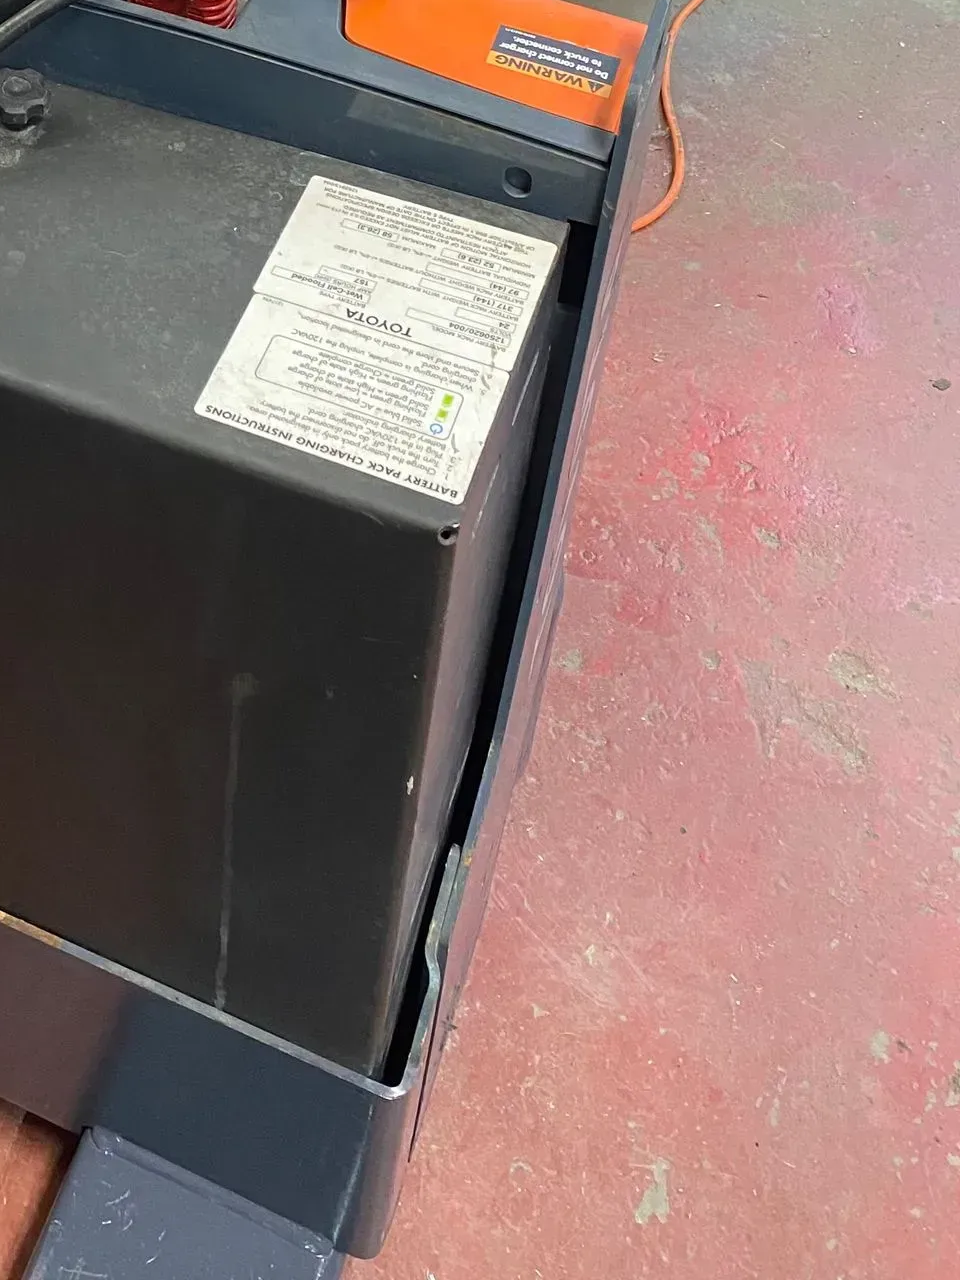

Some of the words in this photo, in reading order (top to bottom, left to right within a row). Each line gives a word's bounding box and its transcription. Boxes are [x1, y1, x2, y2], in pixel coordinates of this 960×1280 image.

[499, 42, 537, 59] charger
[513, 36, 562, 54] connector.
[539, 53, 574, 70] connect
[563, 51, 589, 66] truck
[591, 58, 602, 67] to
[495, 54, 583, 88] WARNING
[575, 63, 593, 74] not
[594, 69, 609, 80] Do
[290, 271, 326, 288] Flooded
[352, 276, 370, 286] 157
[325, 283, 364, 300] Wet-Cell
[488, 281, 507, 292] (44)
[507, 287, 520, 296] 97
[472, 294, 496, 307] (144)
[496, 301, 514, 312] 317
[343, 307, 414, 337] TOYOTA
[497, 321, 510, 330] 24
[247, 404, 268, 416] area.
[256, 398, 287, 414] battery.
[305, 405, 327, 419] cord.
[286, 408, 301, 419] the
[203, 402, 293, 441] INSTRUCTIONS
[267, 411, 311, 432] designated
[300, 413, 343, 433] disconnect
[327, 413, 364, 431] charging
[320, 429, 340, 441] only
[342, 428, 357, 438] not
[357, 433, 370, 443] do
[363, 425, 399, 444] 120VAC
[339, 436, 361, 449] pack
[369, 437, 386, 448] off,
[399, 438, 414, 449] the
[294, 434, 364, 466] CHARGING
[360, 443, 390, 459] battery
[385, 443, 407, 456] truck
[406, 450, 421, 461] the
[423, 446, 443, 459] Plug
[390, 453, 405, 464] the
[421, 455, 440, 467] Turn
[366, 459, 401, 479] PACK
[404, 459, 436, 476] Charge
[403, 472, 458, 499] BATTERY
